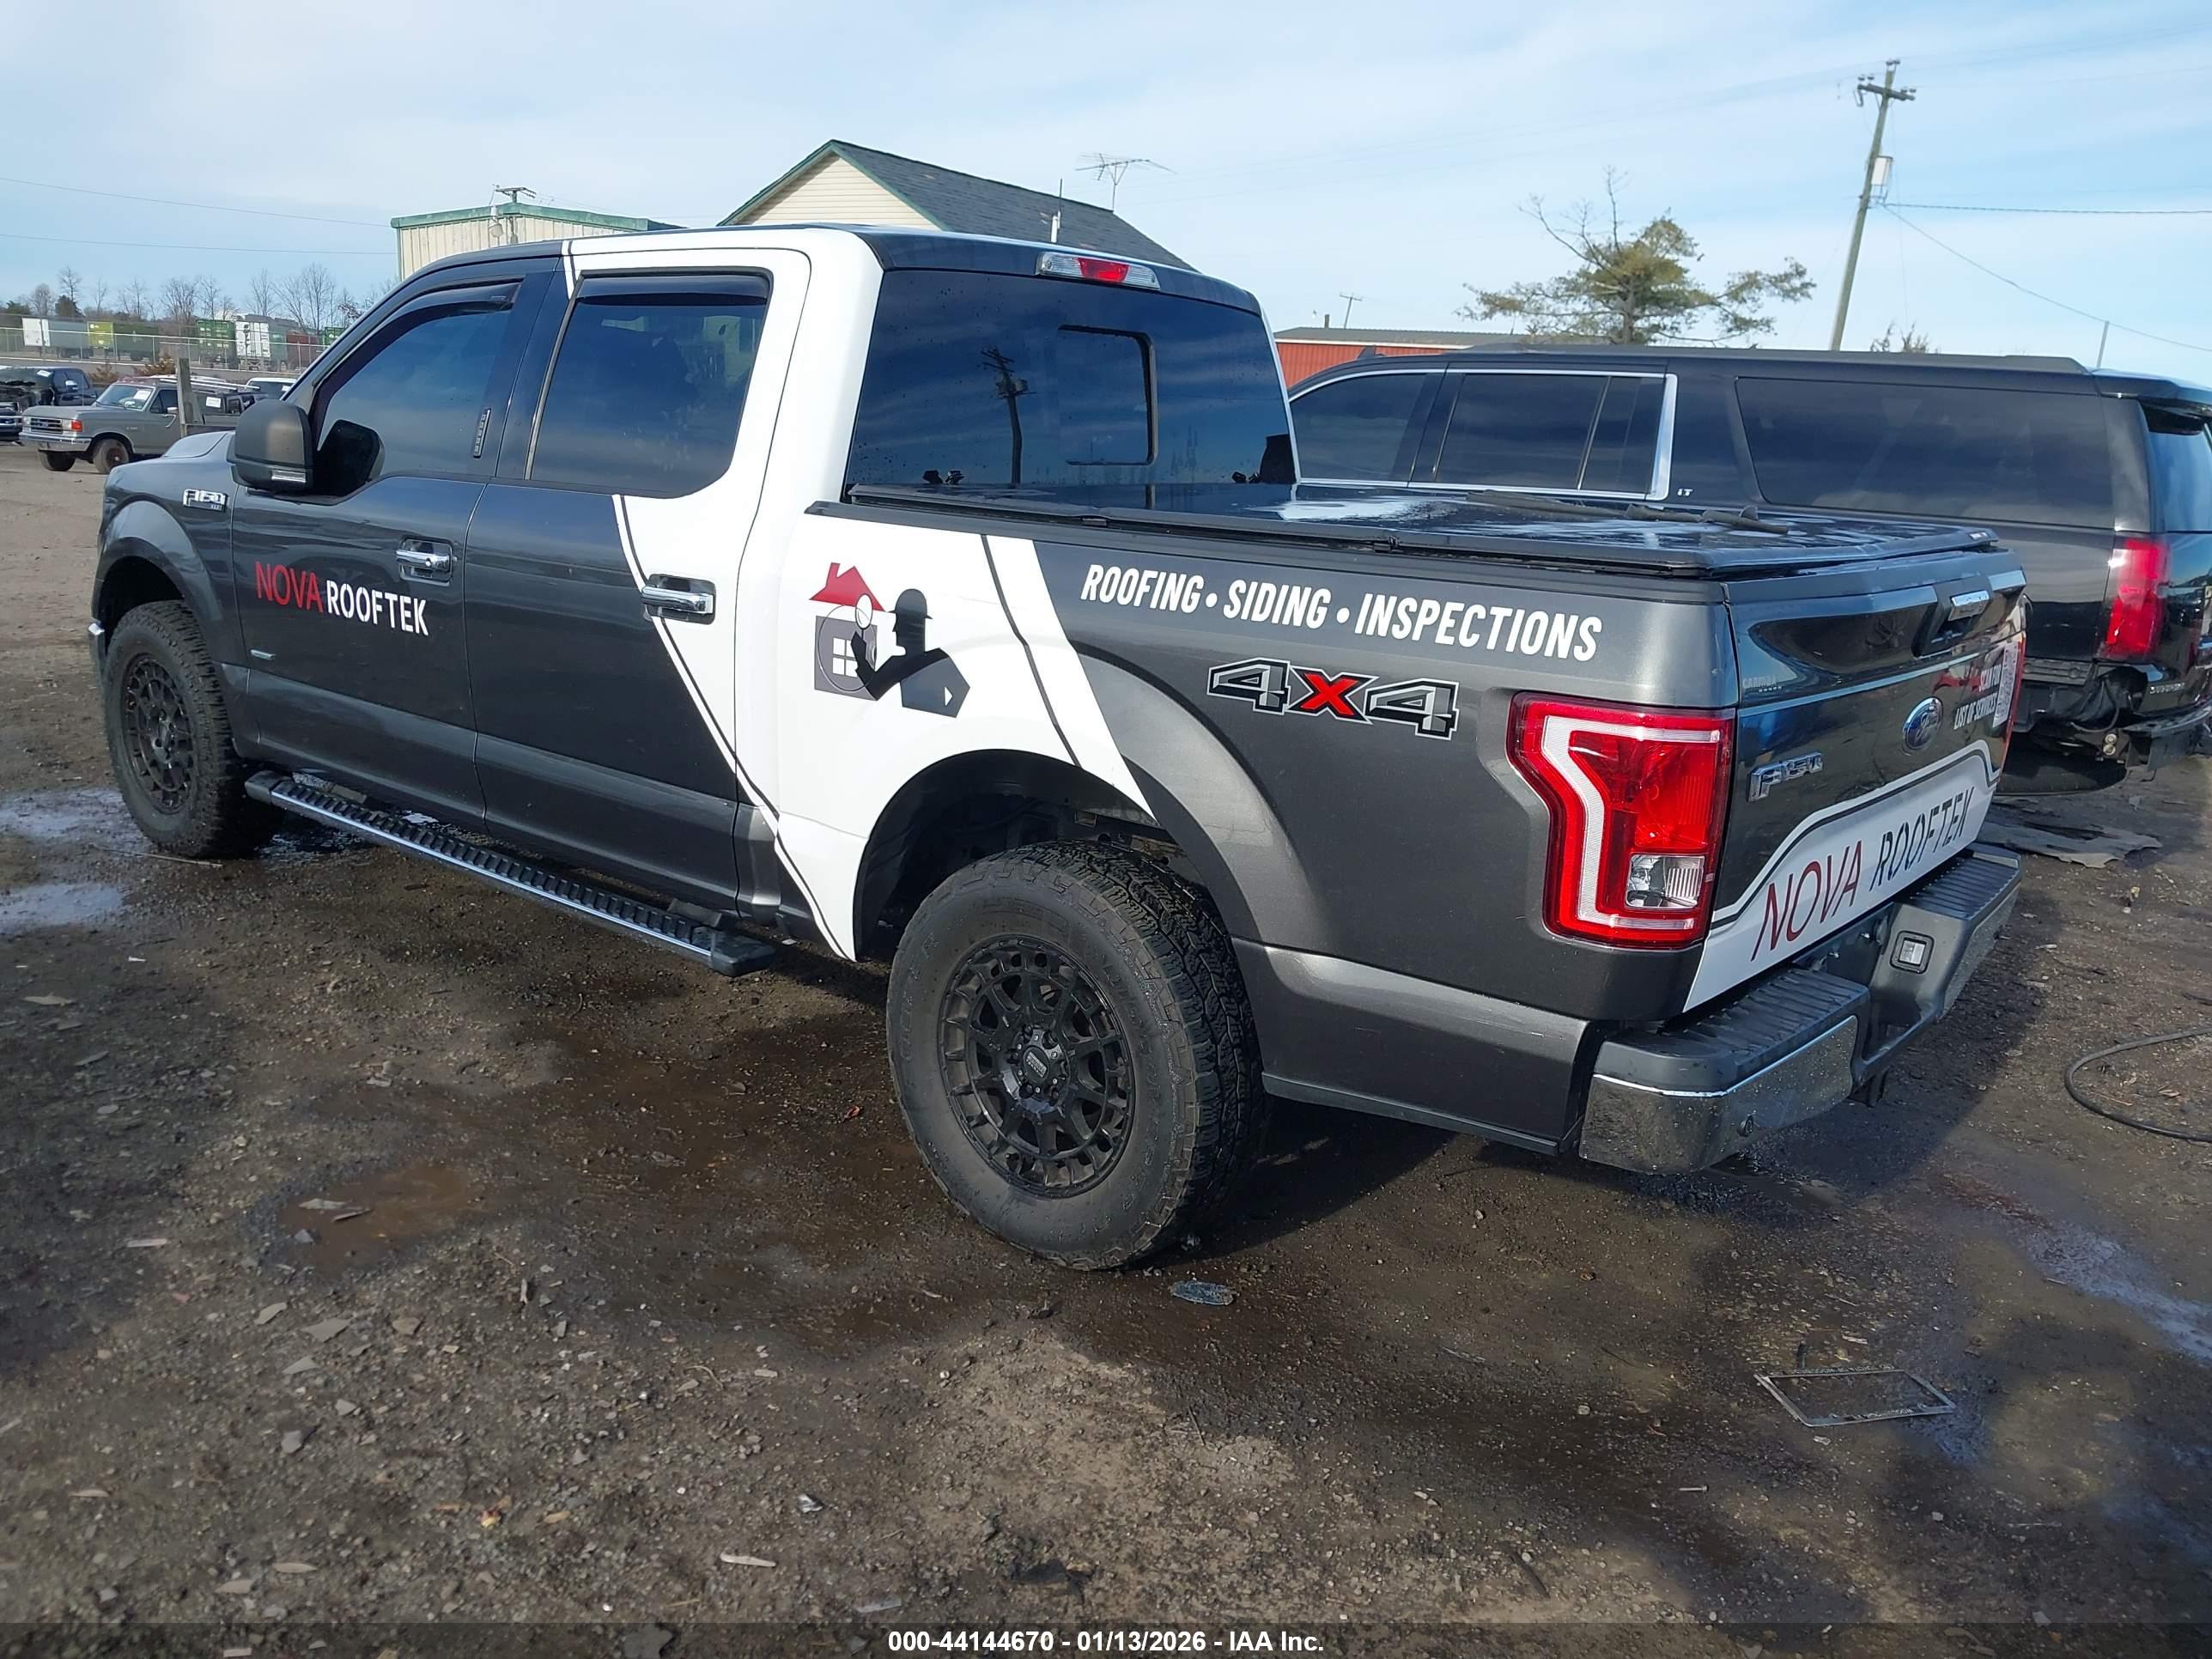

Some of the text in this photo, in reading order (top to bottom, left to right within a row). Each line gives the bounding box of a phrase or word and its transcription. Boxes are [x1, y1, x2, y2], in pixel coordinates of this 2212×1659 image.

[254, 561, 428, 635] NOVA ROOFTEK
[1080, 563, 1603, 662] ROOFING SIDING INSPECTIONS
[1954, 705, 1968, 729] LIST
[1967, 702, 1976, 724] OF
[1750, 786, 1975, 963] NOVA ROOFTEK
